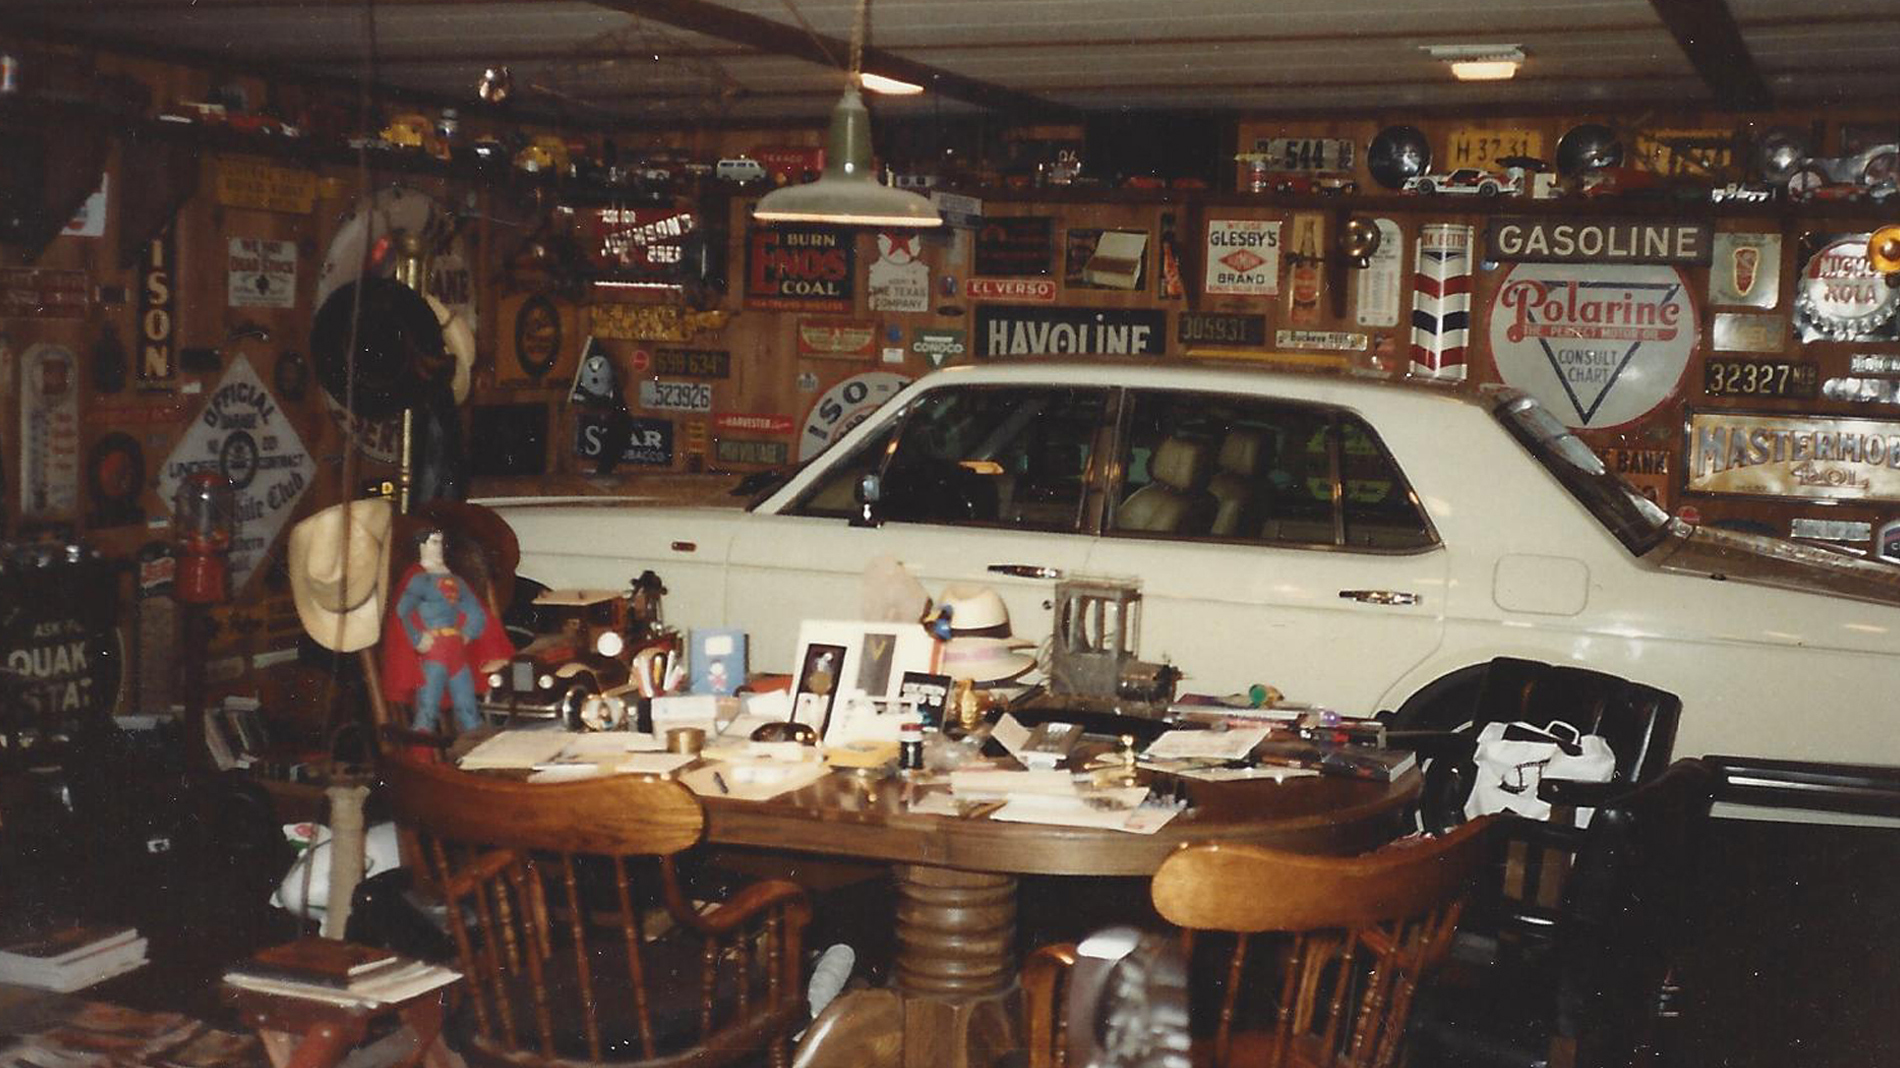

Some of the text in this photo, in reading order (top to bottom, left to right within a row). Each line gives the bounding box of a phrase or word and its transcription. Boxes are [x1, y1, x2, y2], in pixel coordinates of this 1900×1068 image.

[787, 233, 836, 247] BURN
[1210, 230, 1277, 247] GLESBY'S
[1499, 224, 1699, 257] GASOLINE
[781, 280, 840, 296] COAL
[972, 283, 1049, 296] EL VERSO
[1217, 272, 1265, 285] BRAND
[144, 225, 171, 378] ISON
[894, 286, 927, 298] TEXAS
[1823, 284, 1876, 304] KOLA
[1501, 279, 1680, 343] Polarine
[913, 342, 964, 354] CONOCO
[989, 315, 1151, 356] HAVOLINE
[1558, 351, 1617, 365] CONSULT
[1567, 367, 1611, 382] CHART
[1710, 363, 1790, 394] 32327
[204, 382, 275, 427] OFFICIAL
[655, 384, 709, 409] 523926
[726, 416, 771, 429] HARVESTER
[585, 425, 662, 455] SAR
[1618, 450, 1667, 476] BANK
[267, 473, 305, 510] Club
[7, 641, 88, 679] QUAK
[22, 677, 93, 713] STAT
